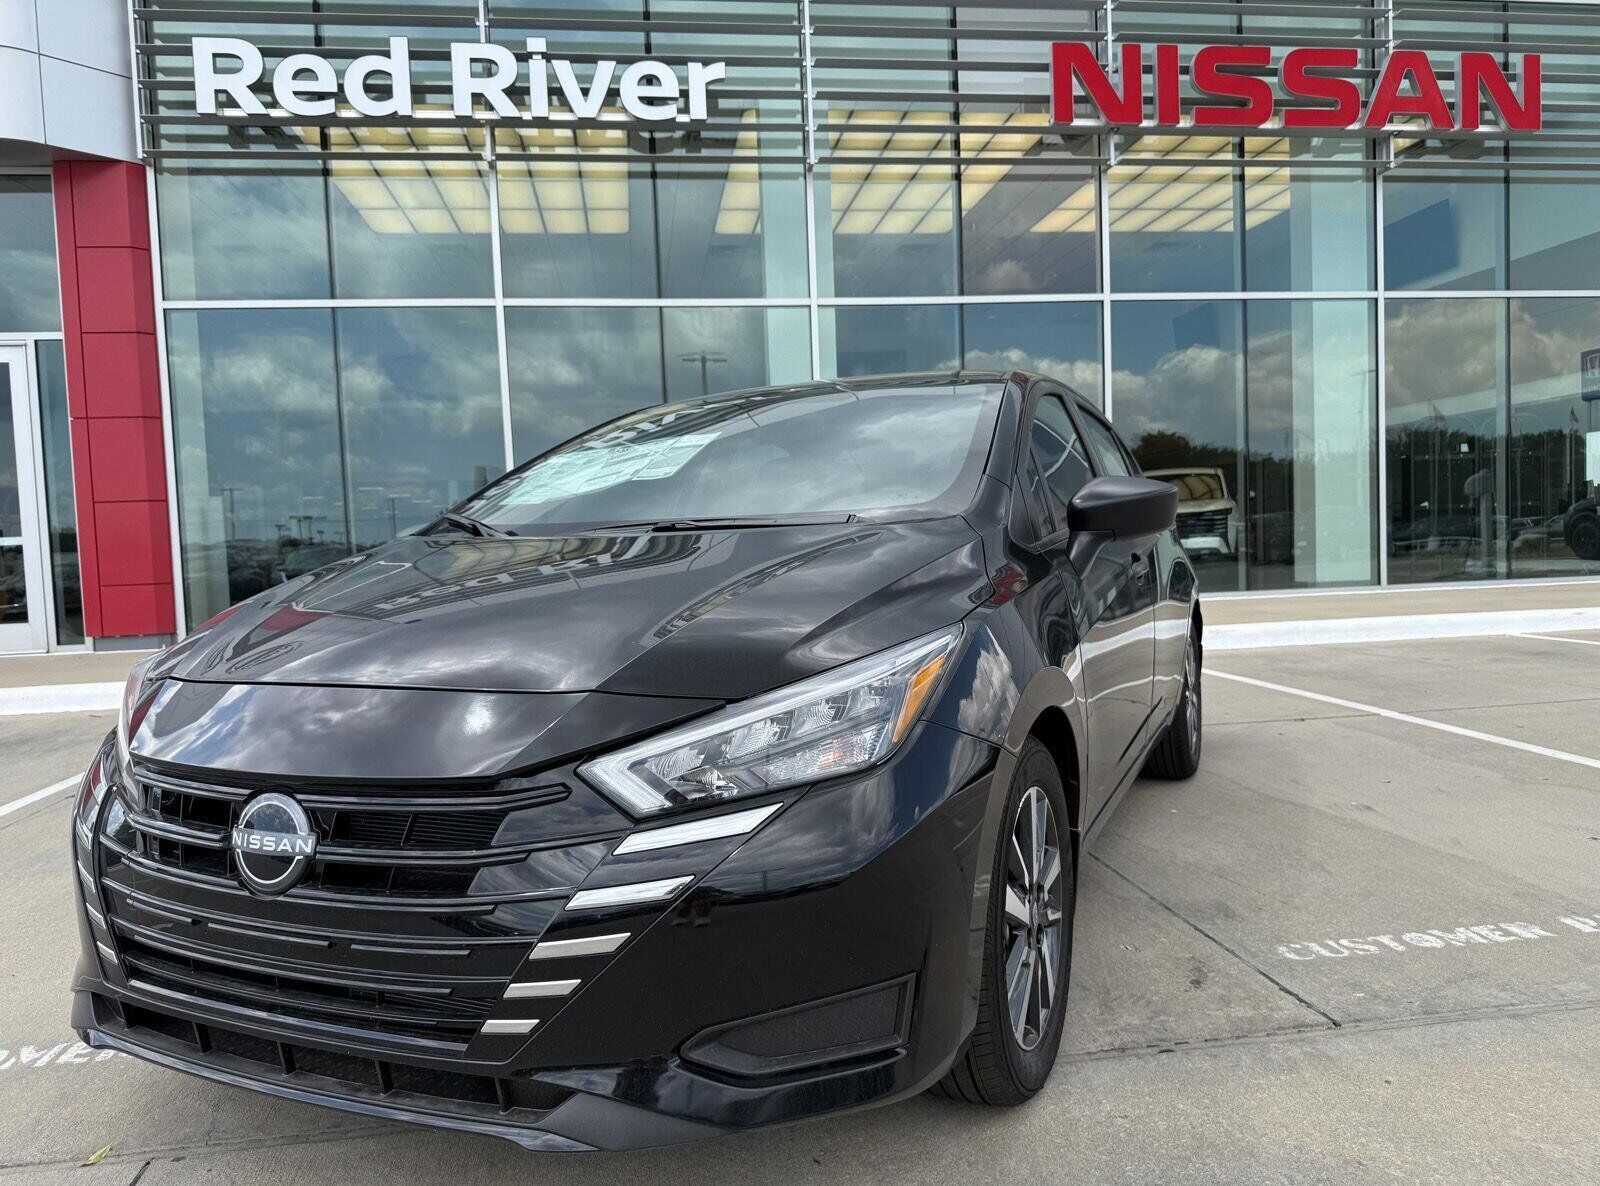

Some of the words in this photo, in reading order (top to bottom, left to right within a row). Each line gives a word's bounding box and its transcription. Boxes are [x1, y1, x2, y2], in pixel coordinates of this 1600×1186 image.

[191, 36, 413, 117] Red
[449, 37, 725, 121] River
[1050, 42, 1542, 132] NISSAN
[232, 830, 313, 853] NISSAN
[1276, 920, 1557, 961] CUSTOMER
